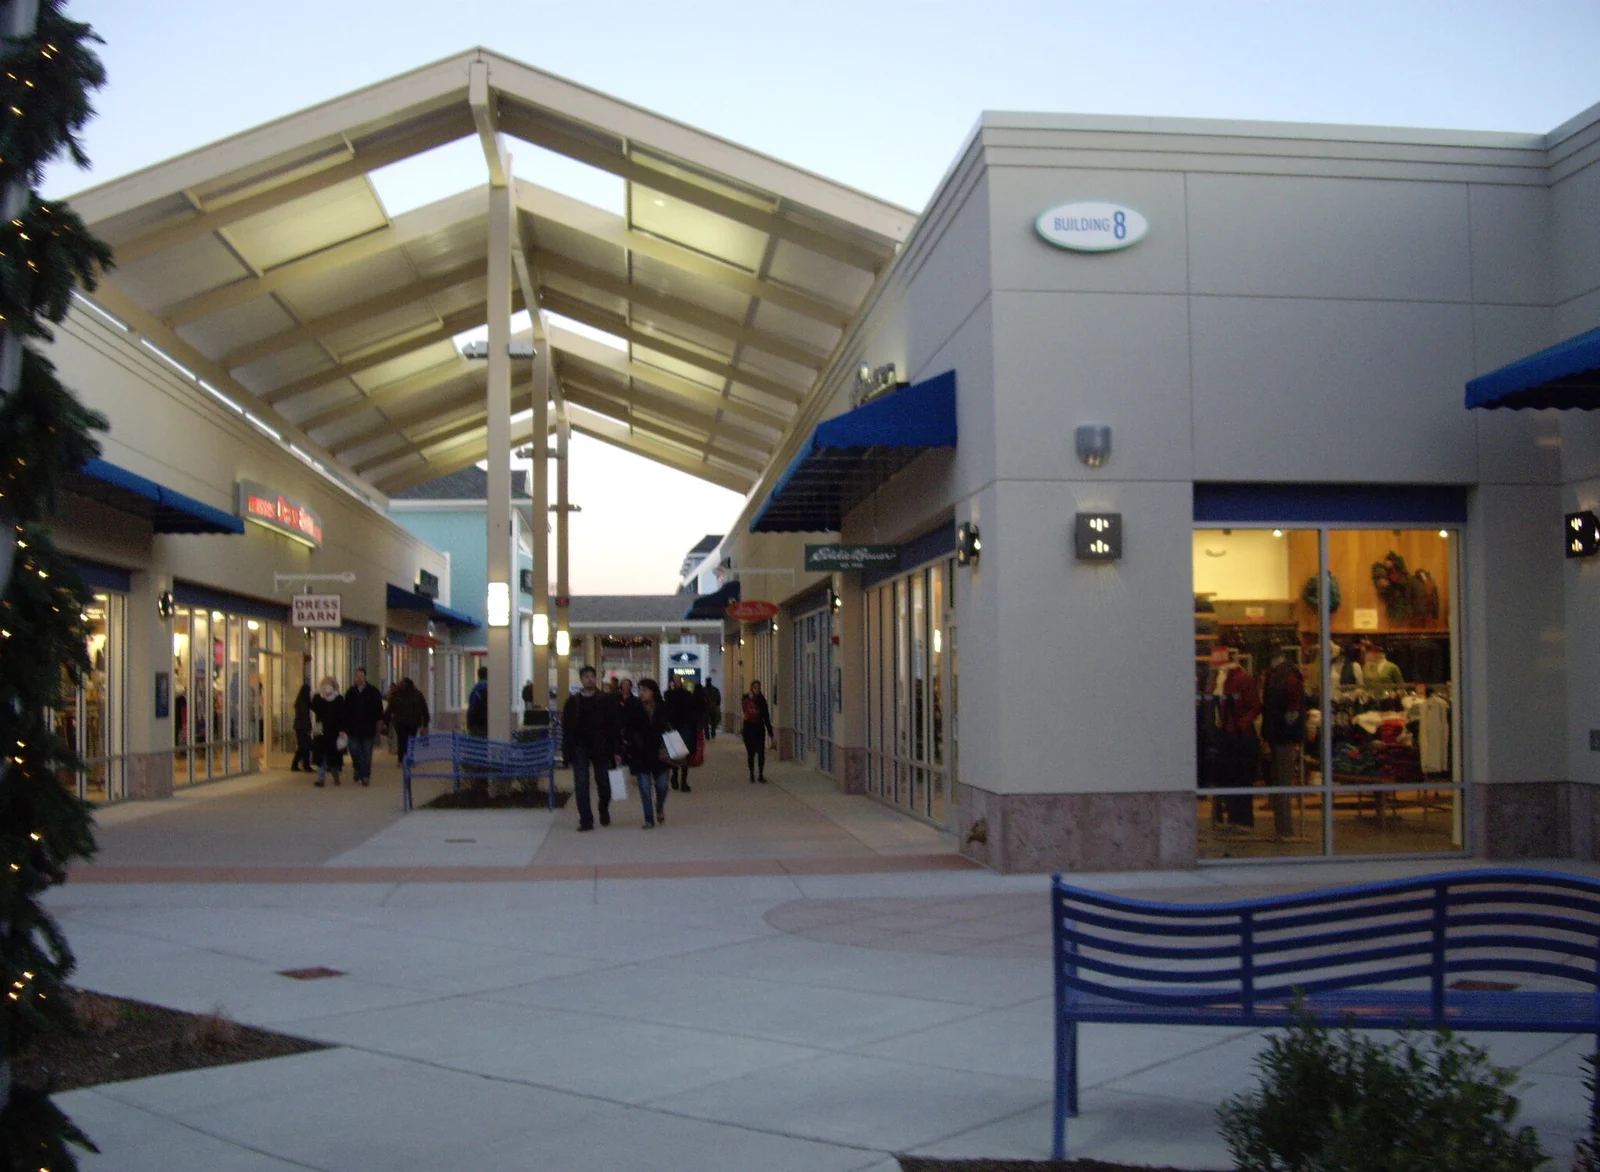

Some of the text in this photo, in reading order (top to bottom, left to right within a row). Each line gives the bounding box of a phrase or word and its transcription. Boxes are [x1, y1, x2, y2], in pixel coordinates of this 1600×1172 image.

[1054, 210, 1126, 240] BUILDING 8
[295, 600, 338, 610] DRESS
[297, 611, 336, 621] BARN
